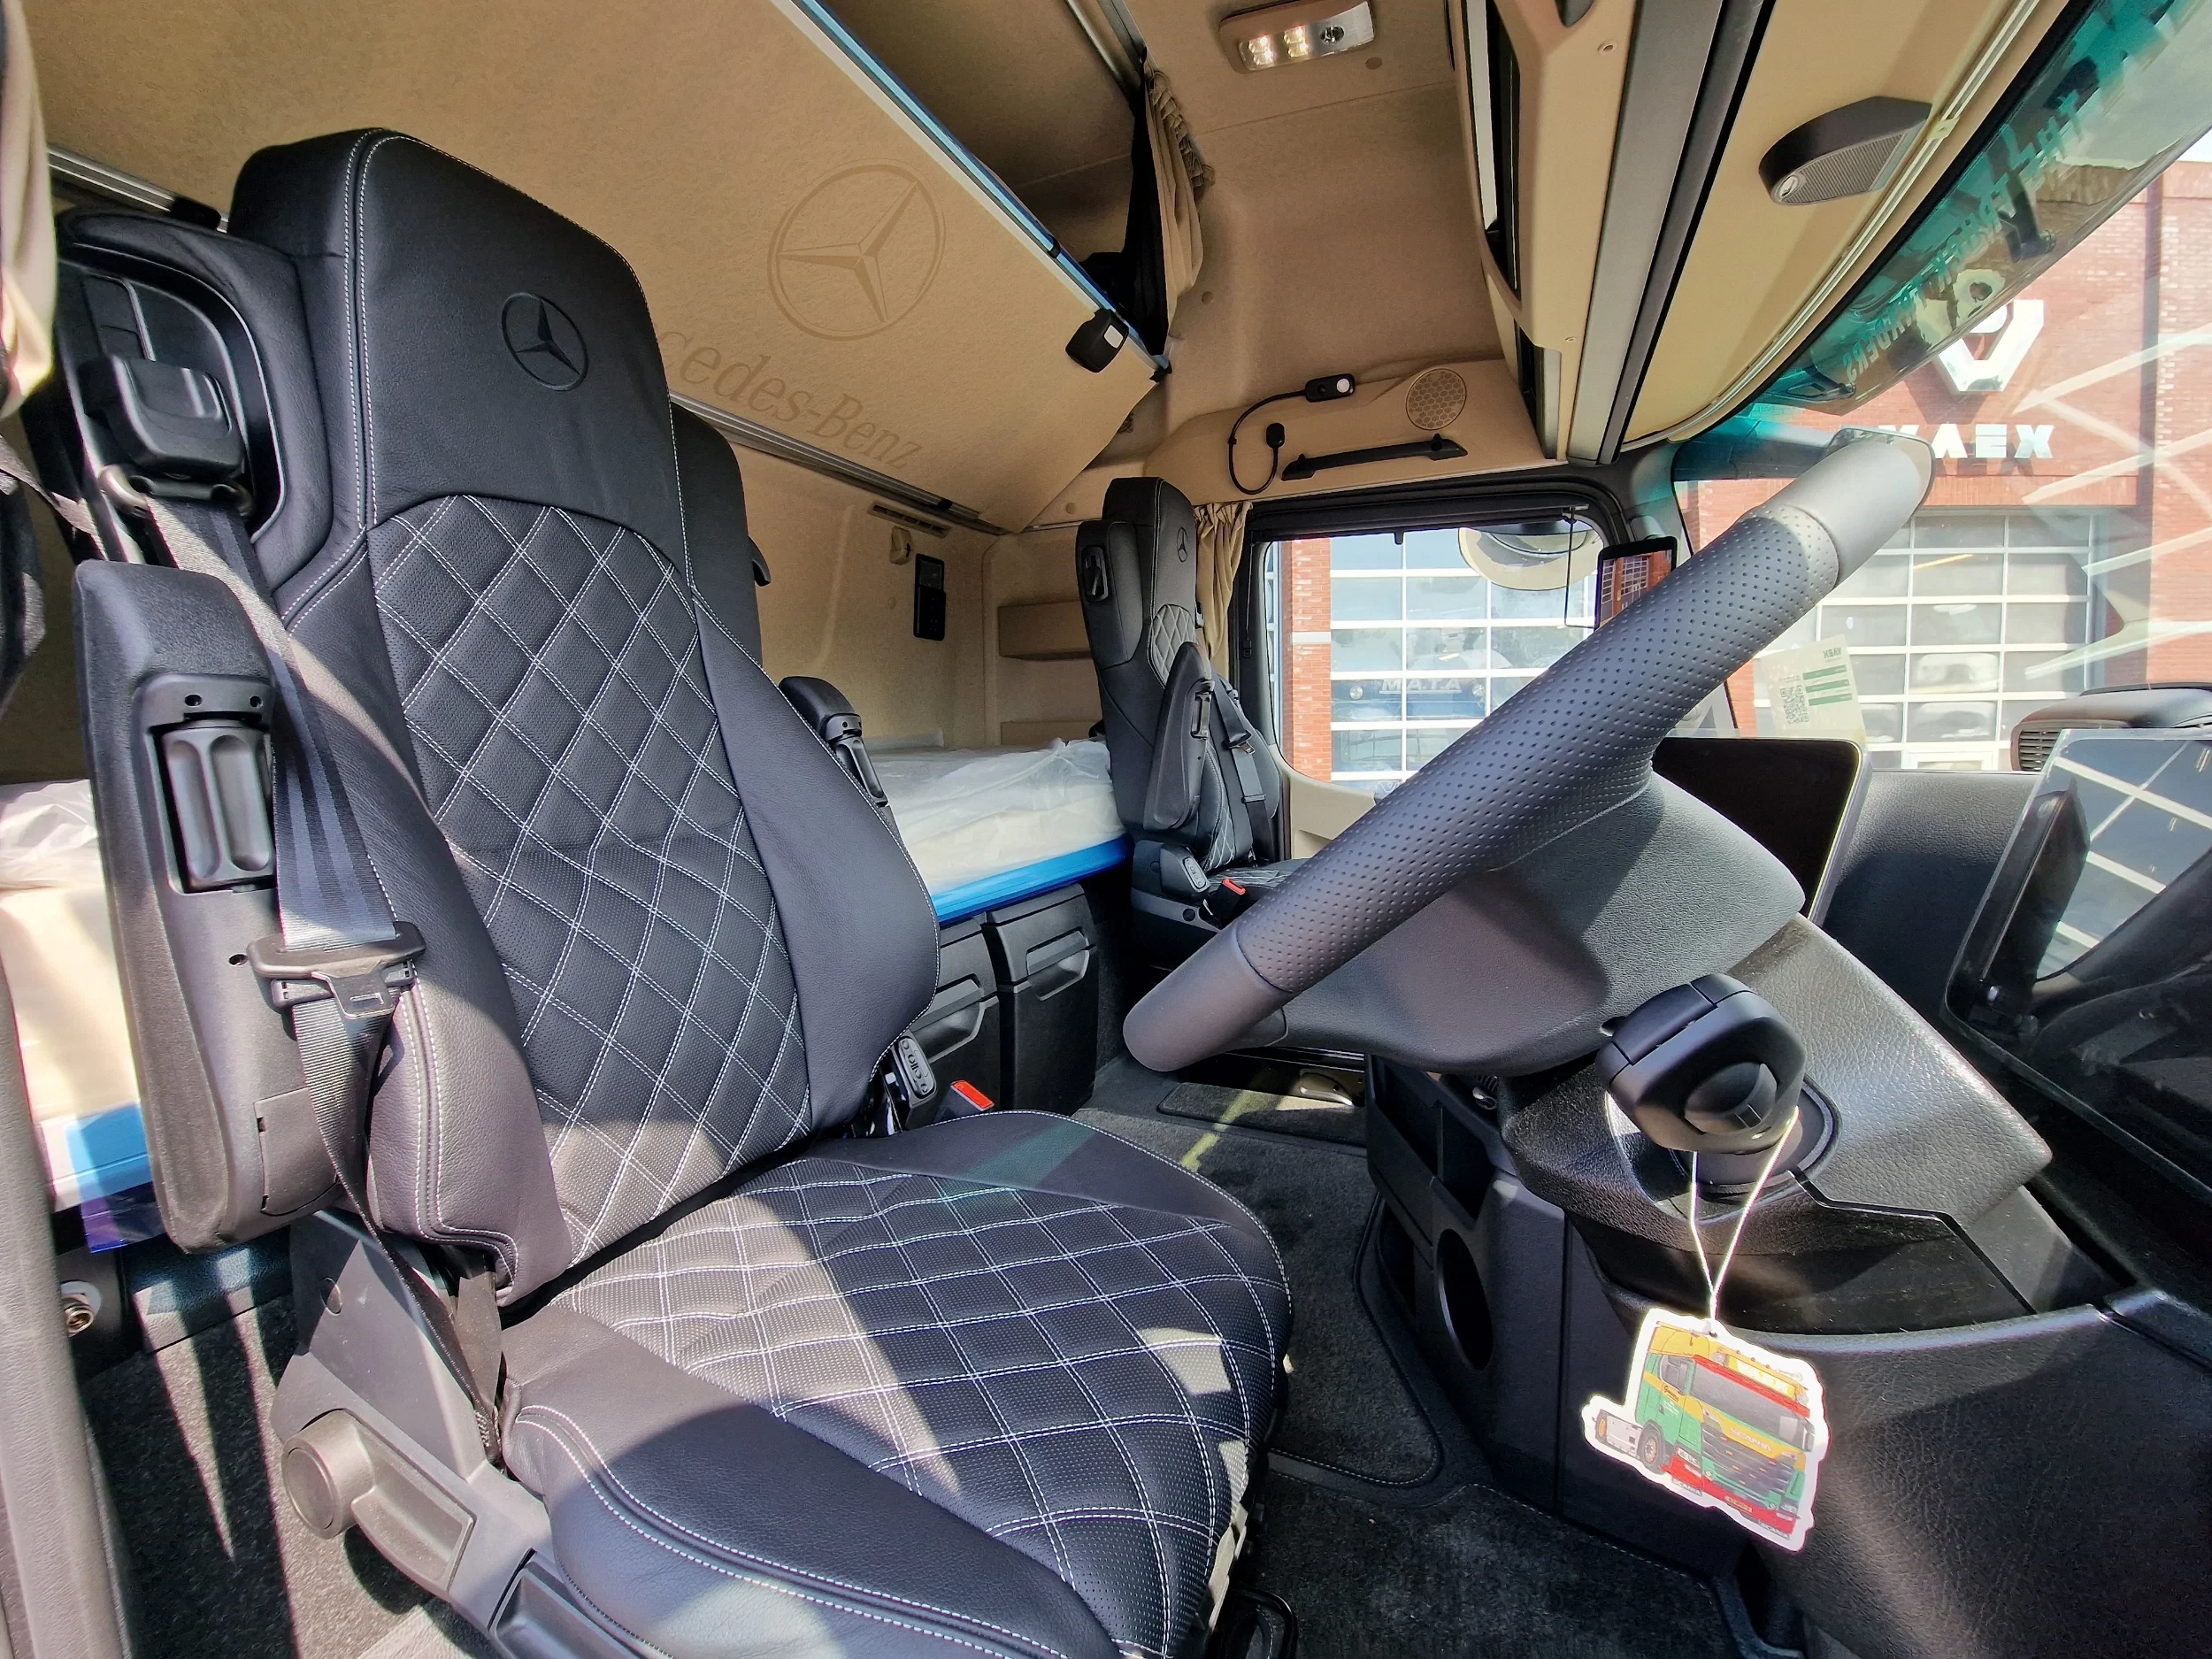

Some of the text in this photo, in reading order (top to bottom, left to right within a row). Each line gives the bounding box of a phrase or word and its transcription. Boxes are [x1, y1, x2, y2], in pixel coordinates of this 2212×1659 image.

[1381, 679, 1463, 691] MA.T.A
[1730, 1427, 1772, 1452] SCANIA
[1672, 1477, 1702, 1496] SCANIA
